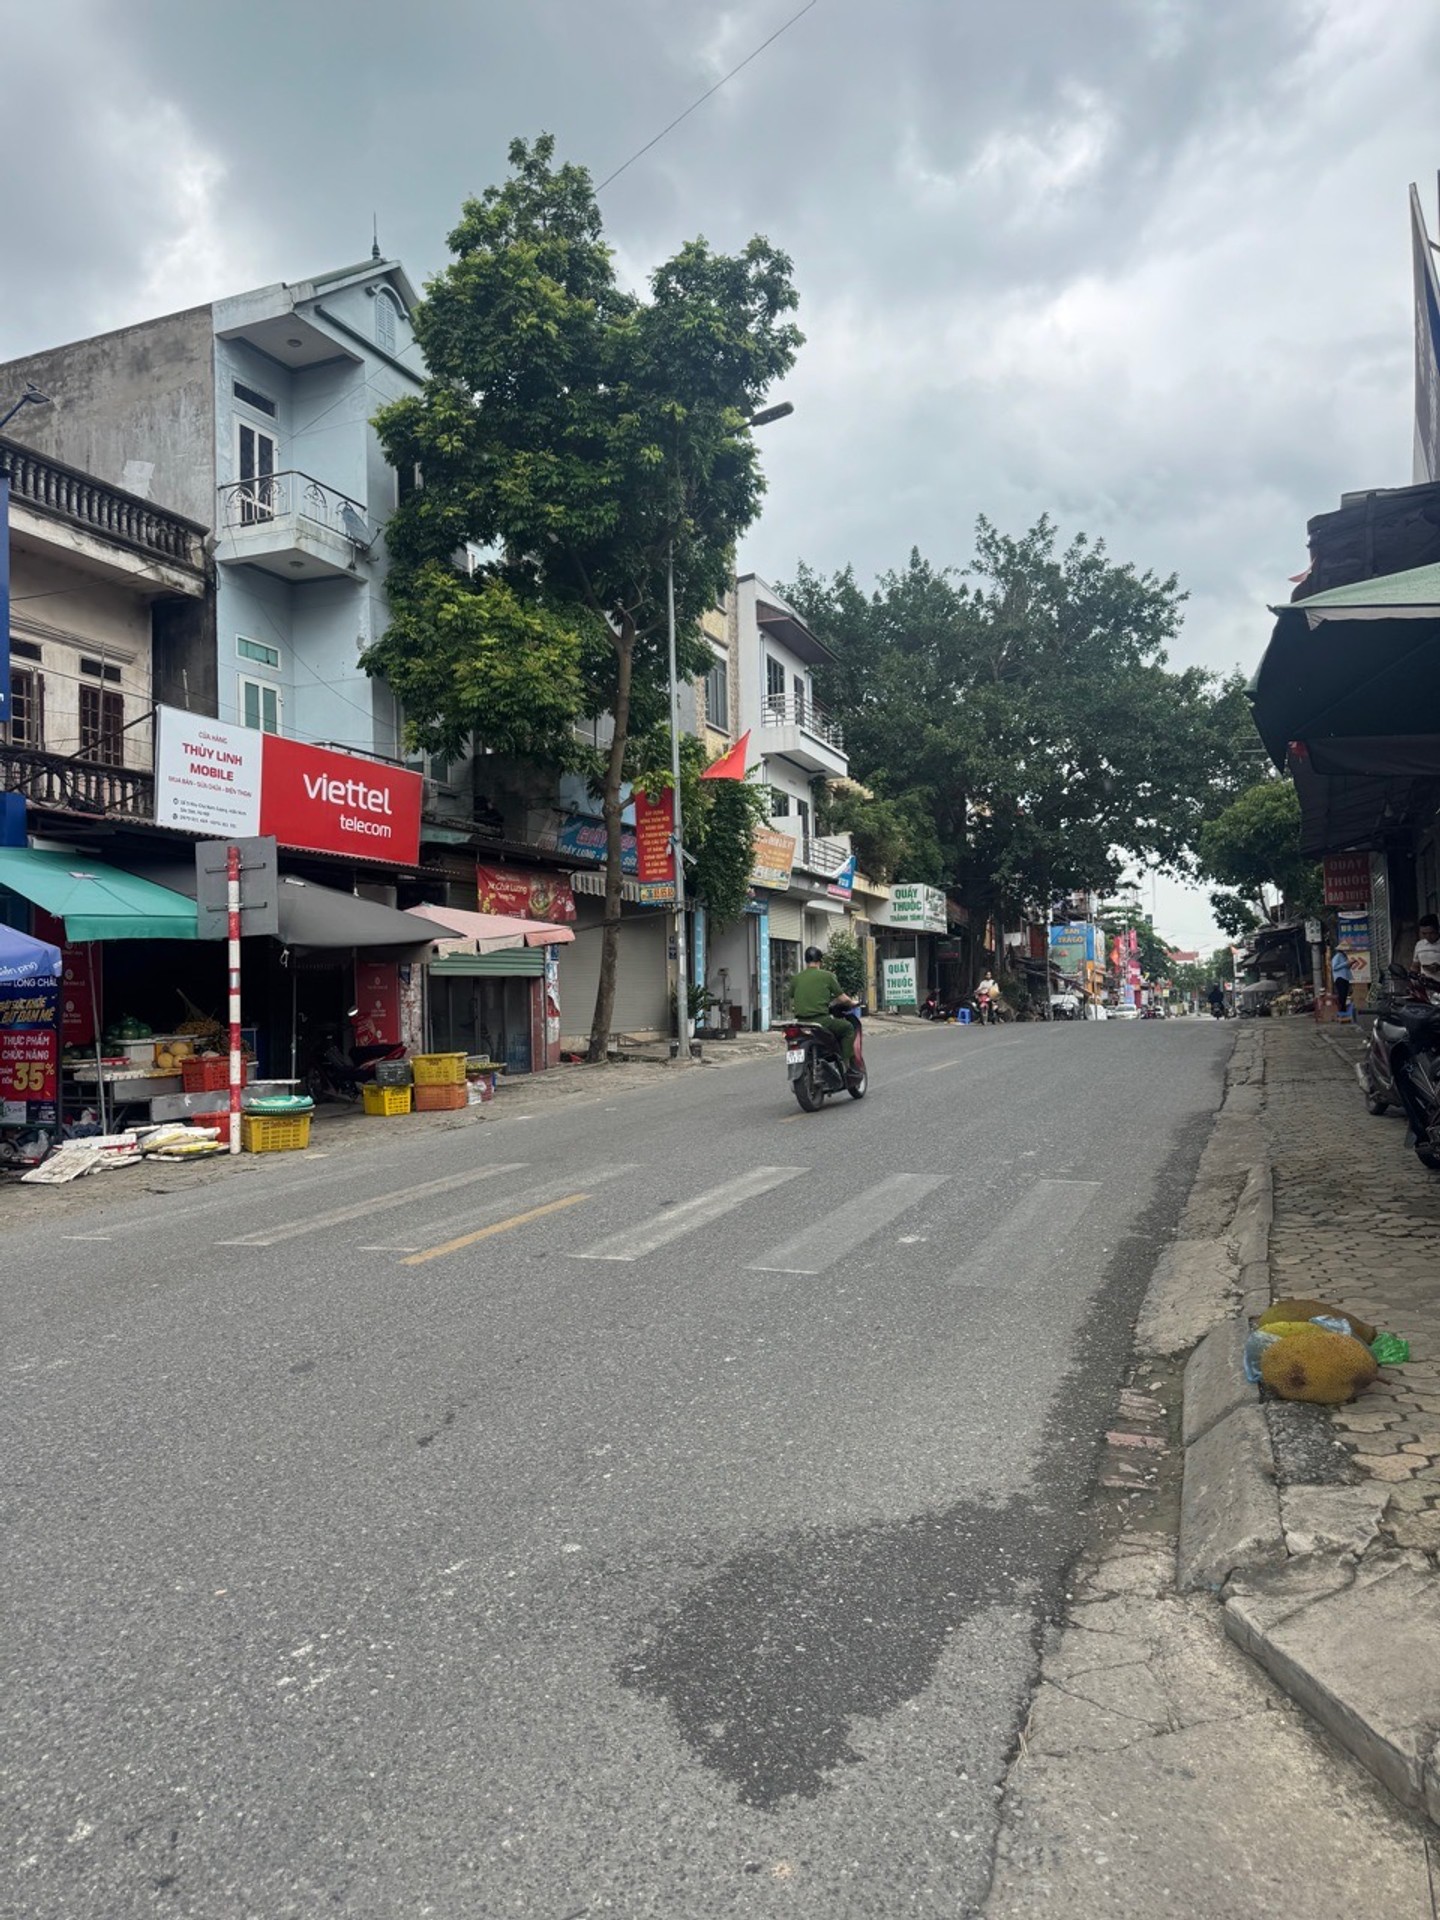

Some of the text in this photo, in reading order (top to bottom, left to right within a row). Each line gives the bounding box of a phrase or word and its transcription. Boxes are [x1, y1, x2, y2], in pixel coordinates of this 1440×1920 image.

[216, 750, 243, 766] LINH
[190, 763, 234, 781] MOBILE
[303, 773, 392, 815] viettel
[339, 814, 392, 838] telecom
[14, 978, 36, 988] LONG
[26, 1032, 50, 1046] PHẨM
[25, 1048, 50, 1060] NĂNG
